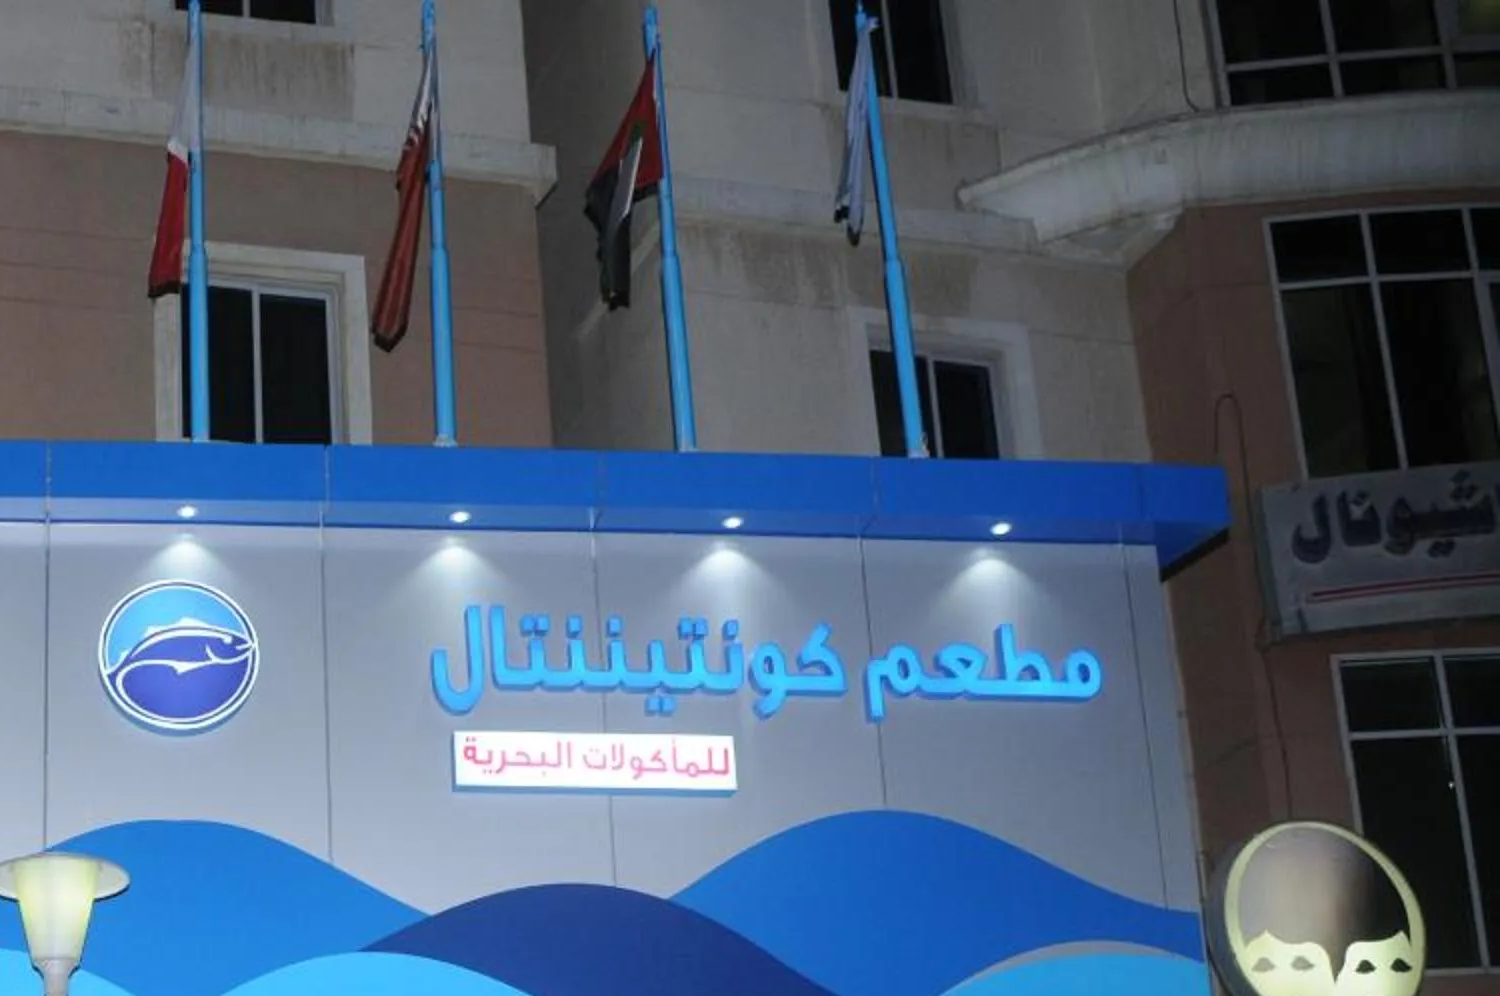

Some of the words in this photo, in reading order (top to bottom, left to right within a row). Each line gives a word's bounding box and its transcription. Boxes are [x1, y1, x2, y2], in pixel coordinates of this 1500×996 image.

[431, 604, 848, 718] كونتيننتال
[864, 623, 1102, 722] مطعم
[462, 736, 573, 779] البحرية
[582, 738, 731, 780] للمأكولات
